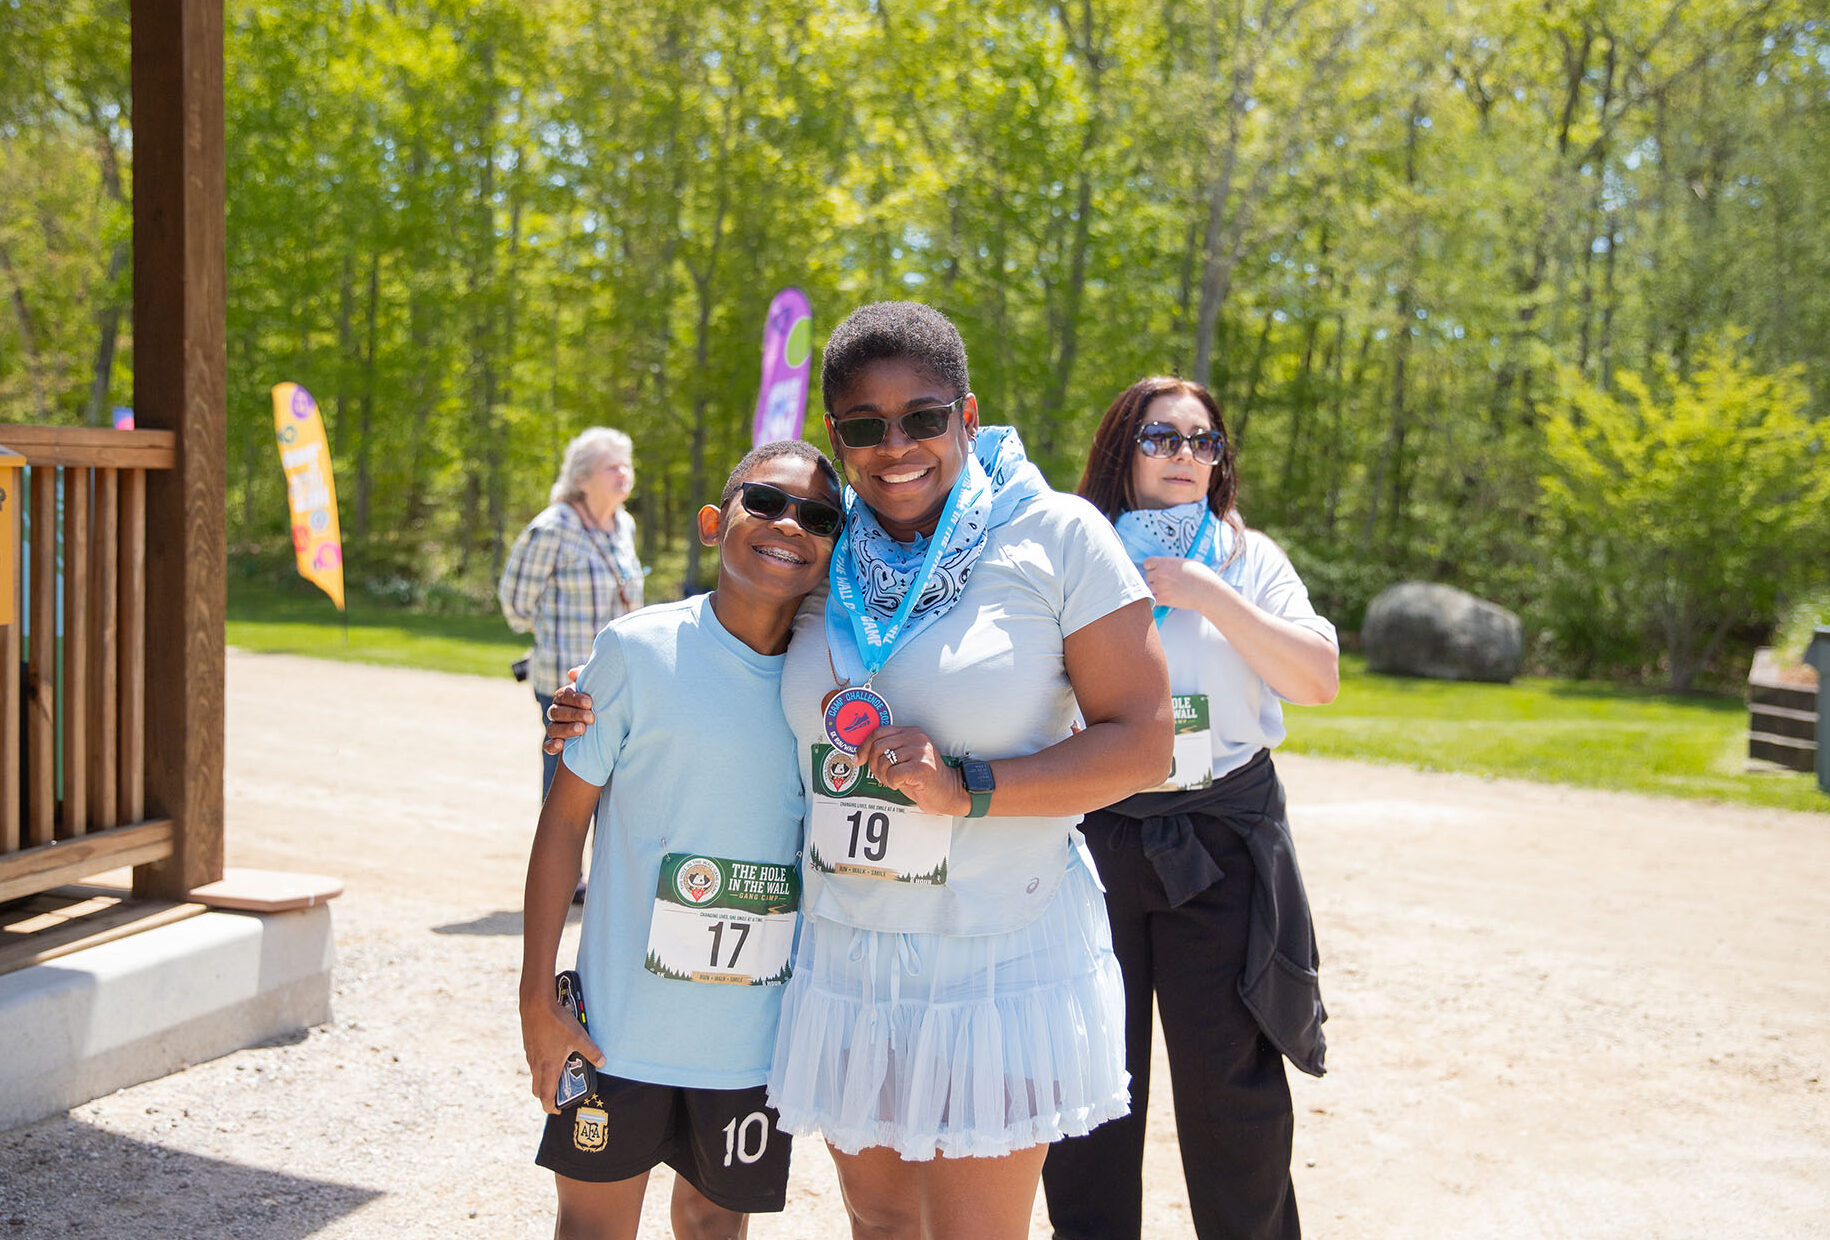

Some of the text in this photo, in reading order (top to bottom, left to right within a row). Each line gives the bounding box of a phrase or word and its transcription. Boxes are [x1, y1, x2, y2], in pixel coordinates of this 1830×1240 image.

[836, 576, 854, 600] WALL
[860, 615, 882, 648] CAMP
[828, 691, 890, 727] CAMP CHALLENGE 202
[1172, 696, 1191, 709] OLE
[846, 810, 890, 862] 19
[731, 863, 787, 882] THE HOLE
[728, 878, 790, 895] IN THE WALL
[738, 892, 779, 902] GANG CAMP
[707, 921, 751, 969] 17
[580, 1120, 601, 1142] AFA
[722, 1111, 769, 1167] 10
